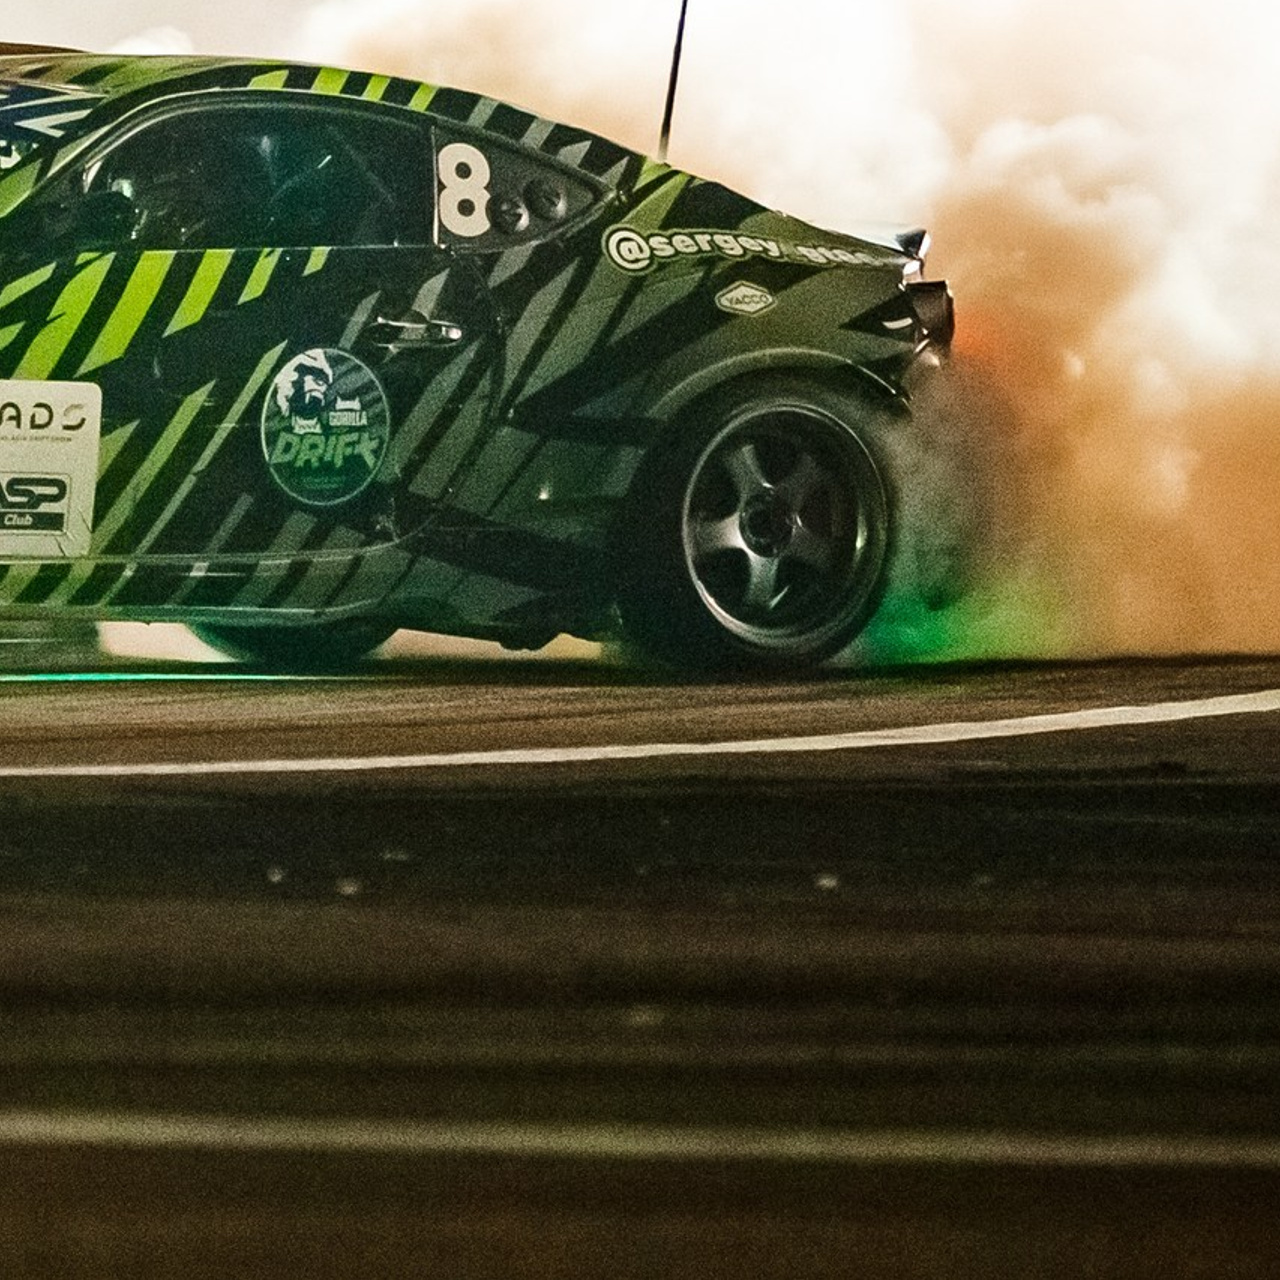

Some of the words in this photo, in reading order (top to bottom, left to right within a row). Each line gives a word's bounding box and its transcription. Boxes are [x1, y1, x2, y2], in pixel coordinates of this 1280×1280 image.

[438, 142, 491, 237] 8
[725, 293, 769, 306] YACCO
[3, 514, 34, 525] Club
